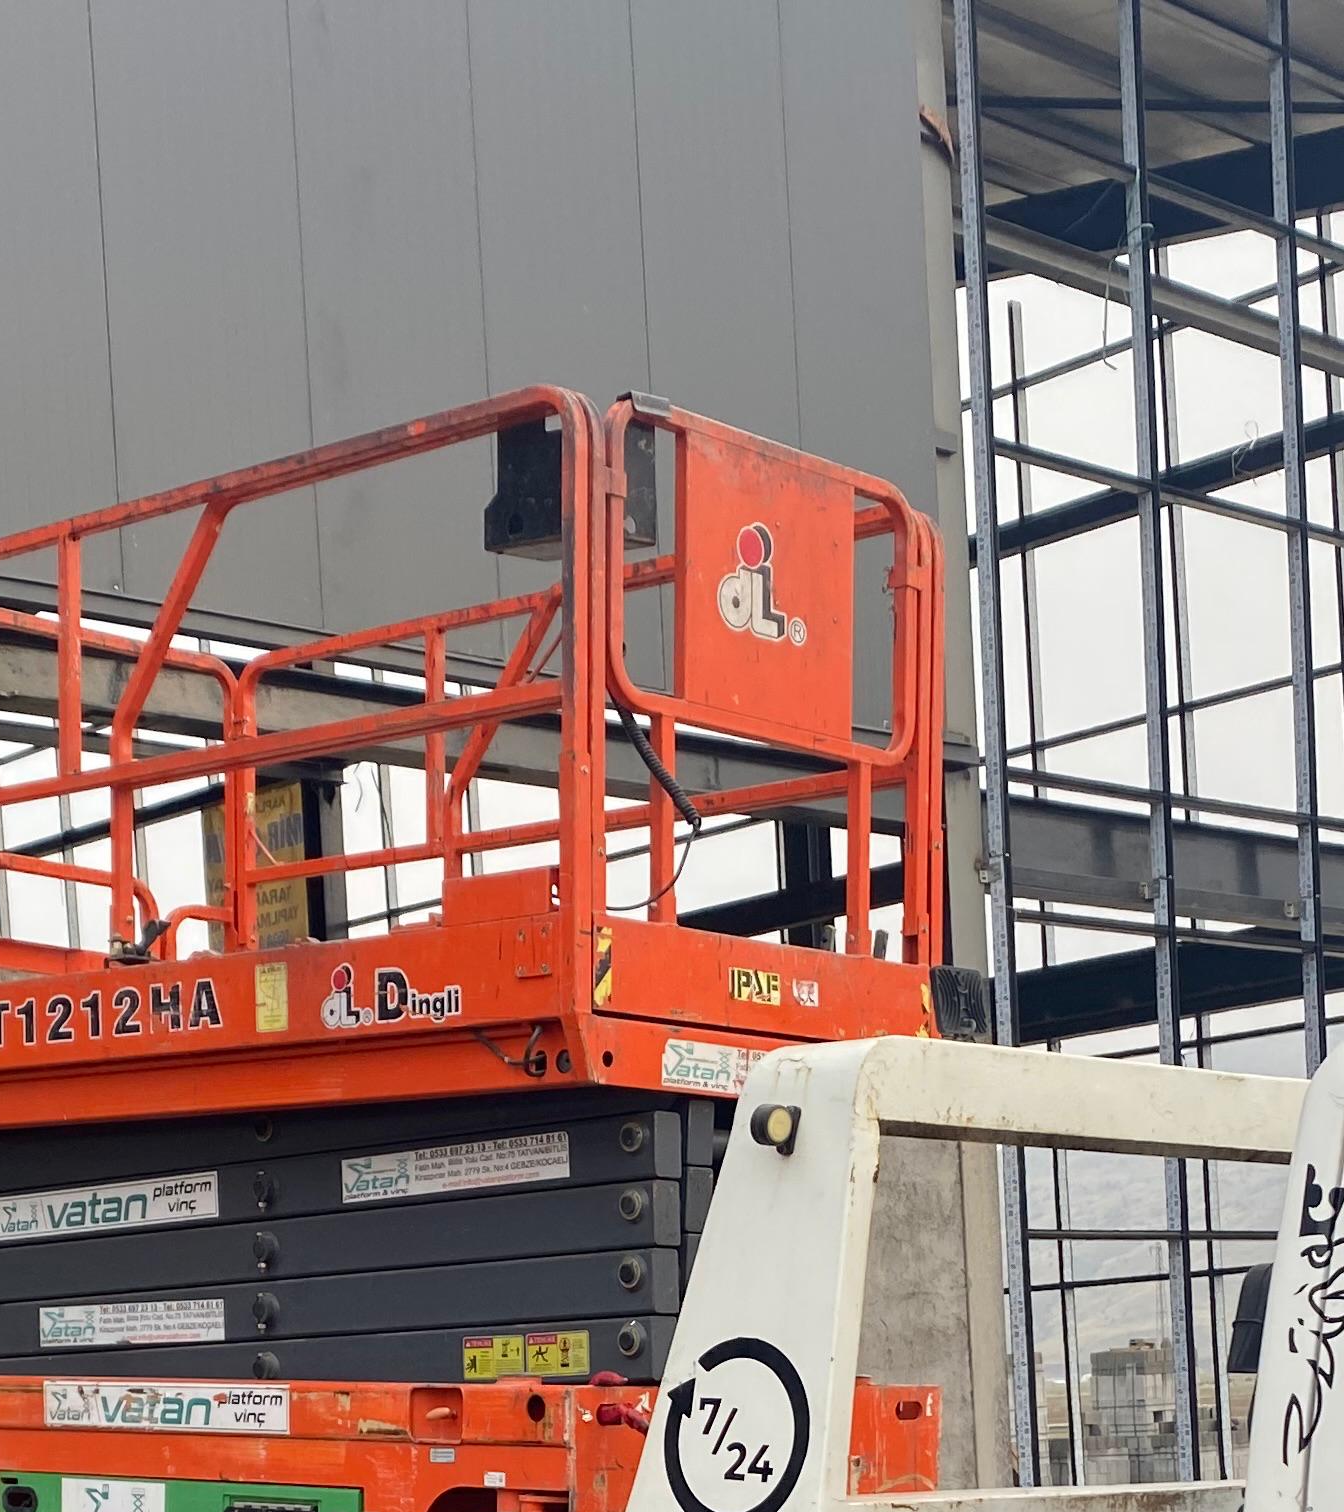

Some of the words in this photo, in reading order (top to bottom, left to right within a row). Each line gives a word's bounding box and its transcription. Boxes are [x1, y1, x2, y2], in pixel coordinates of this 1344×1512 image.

[376, 968, 461, 1022] Dingli
[153, 1180, 212, 1201] platform
[168, 1198, 197, 1214] vinç
[217, 1390, 282, 1408] platform
[234, 1408, 266, 1427] vinç
